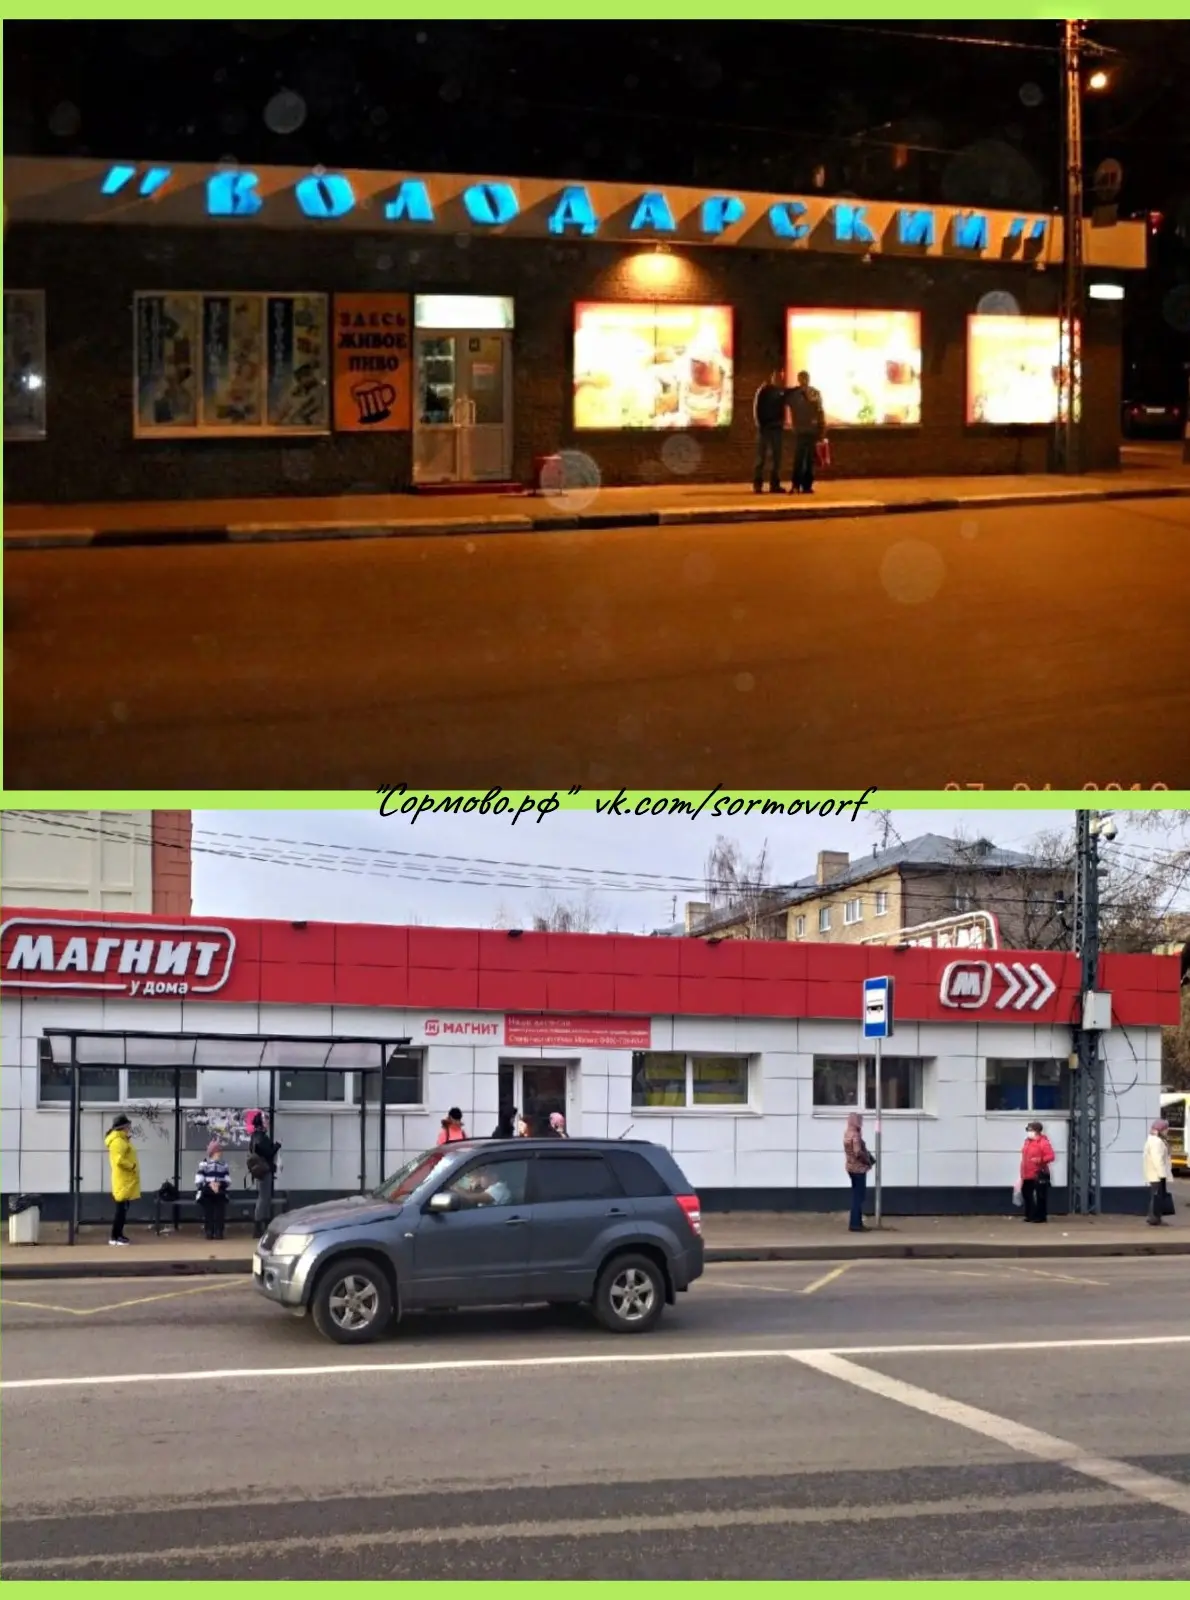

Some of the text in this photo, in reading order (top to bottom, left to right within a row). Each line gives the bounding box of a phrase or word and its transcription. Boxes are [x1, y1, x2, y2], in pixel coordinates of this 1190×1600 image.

[339, 312, 406, 327] ЗДЕСЬ
[337, 332, 407, 349] ЖИВОЕ
[348, 355, 399, 372] ПИВО
[7, 935, 221, 976] МАГНИТ
[129, 980, 189, 996] у дома
[443, 1022, 499, 1036] МАГНИТ
